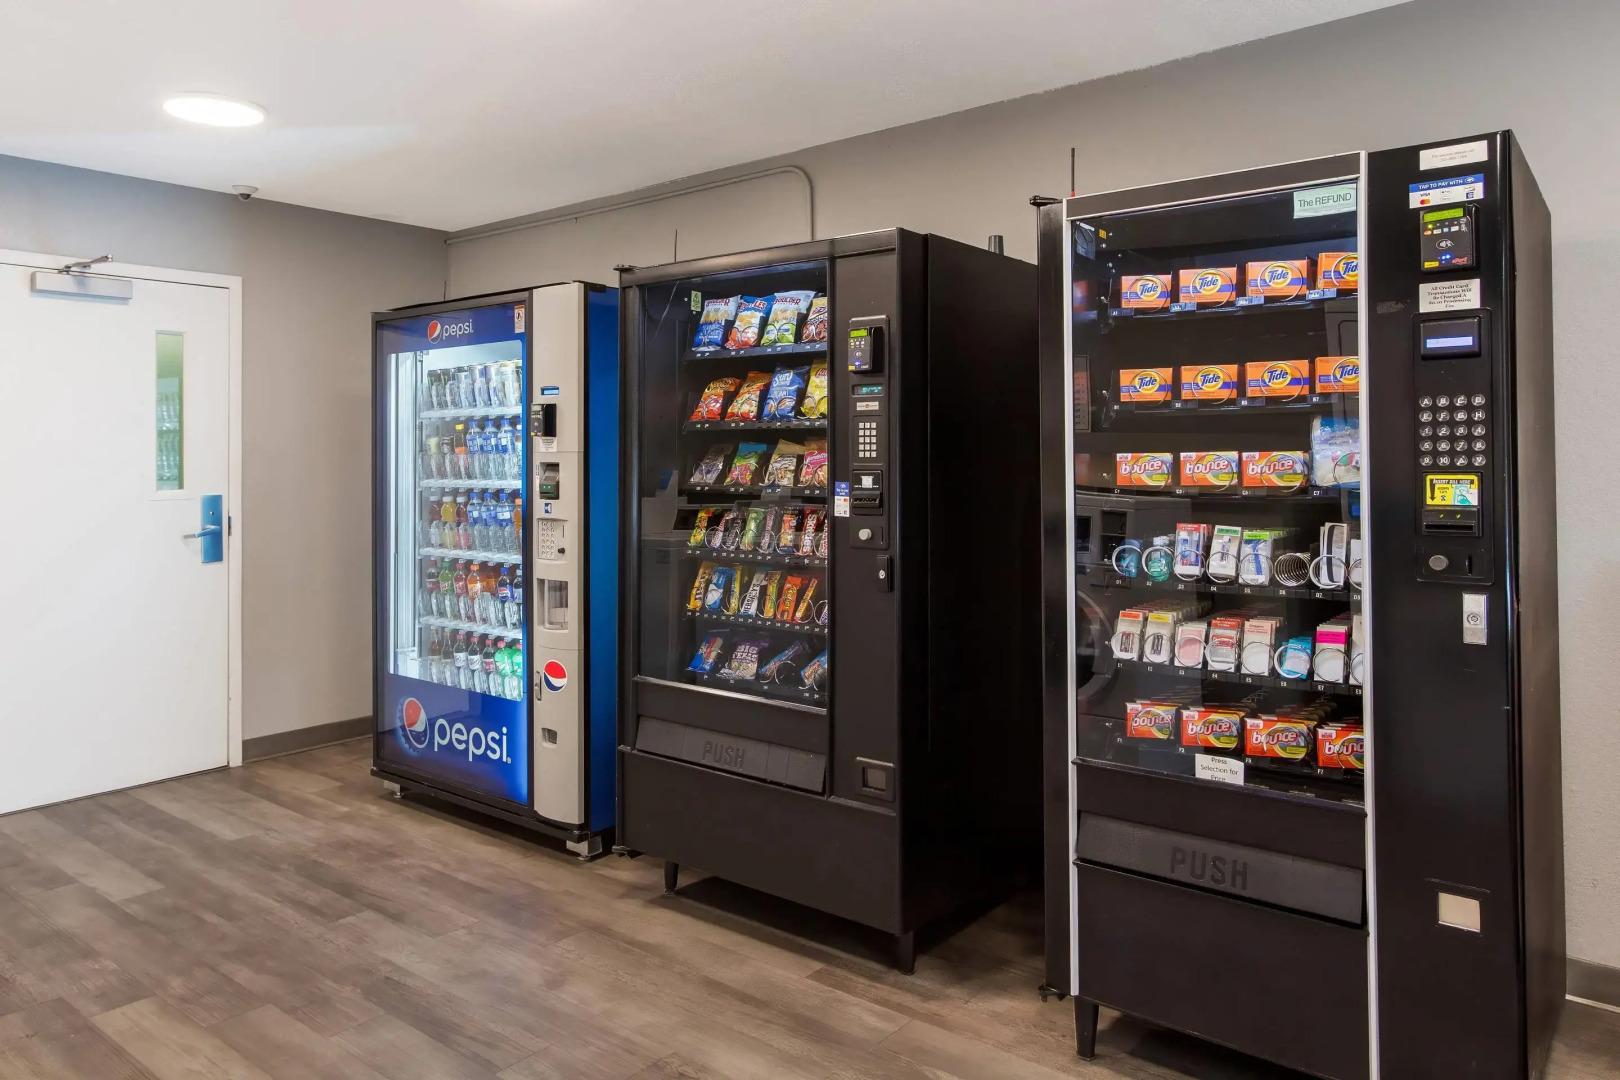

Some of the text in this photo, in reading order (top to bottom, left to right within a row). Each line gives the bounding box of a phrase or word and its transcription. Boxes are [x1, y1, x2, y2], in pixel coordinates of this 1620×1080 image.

[1315, 193, 1351, 205] REFUND
[1342, 260, 1358, 275] Tid
[1268, 269, 1289, 283] Tide
[1140, 283, 1158, 296] Tide
[1198, 277, 1218, 290] Tide
[738, 300, 766, 310] RLES
[443, 319, 473, 340] pepsi
[1267, 369, 1288, 383] Tide
[1338, 365, 1359, 379] Tide
[1138, 377, 1157, 389] Tide
[1200, 373, 1220, 386] Tide
[1121, 460, 1162, 474] bounce
[1185, 459, 1228, 474] bounce
[1248, 459, 1294, 475] bounce
[736, 645, 758, 653] BIG
[733, 652, 758, 661] TEXAS
[1132, 714, 1172, 727] bounce
[1187, 721, 1230, 735] bounce
[434, 718, 507, 762] pepsi
[1252, 731, 1298, 745] bounce
[702, 741, 745, 769] PUSH
[1201, 765, 1228, 773] Selection
[1170, 846, 1248, 891] PUSH
